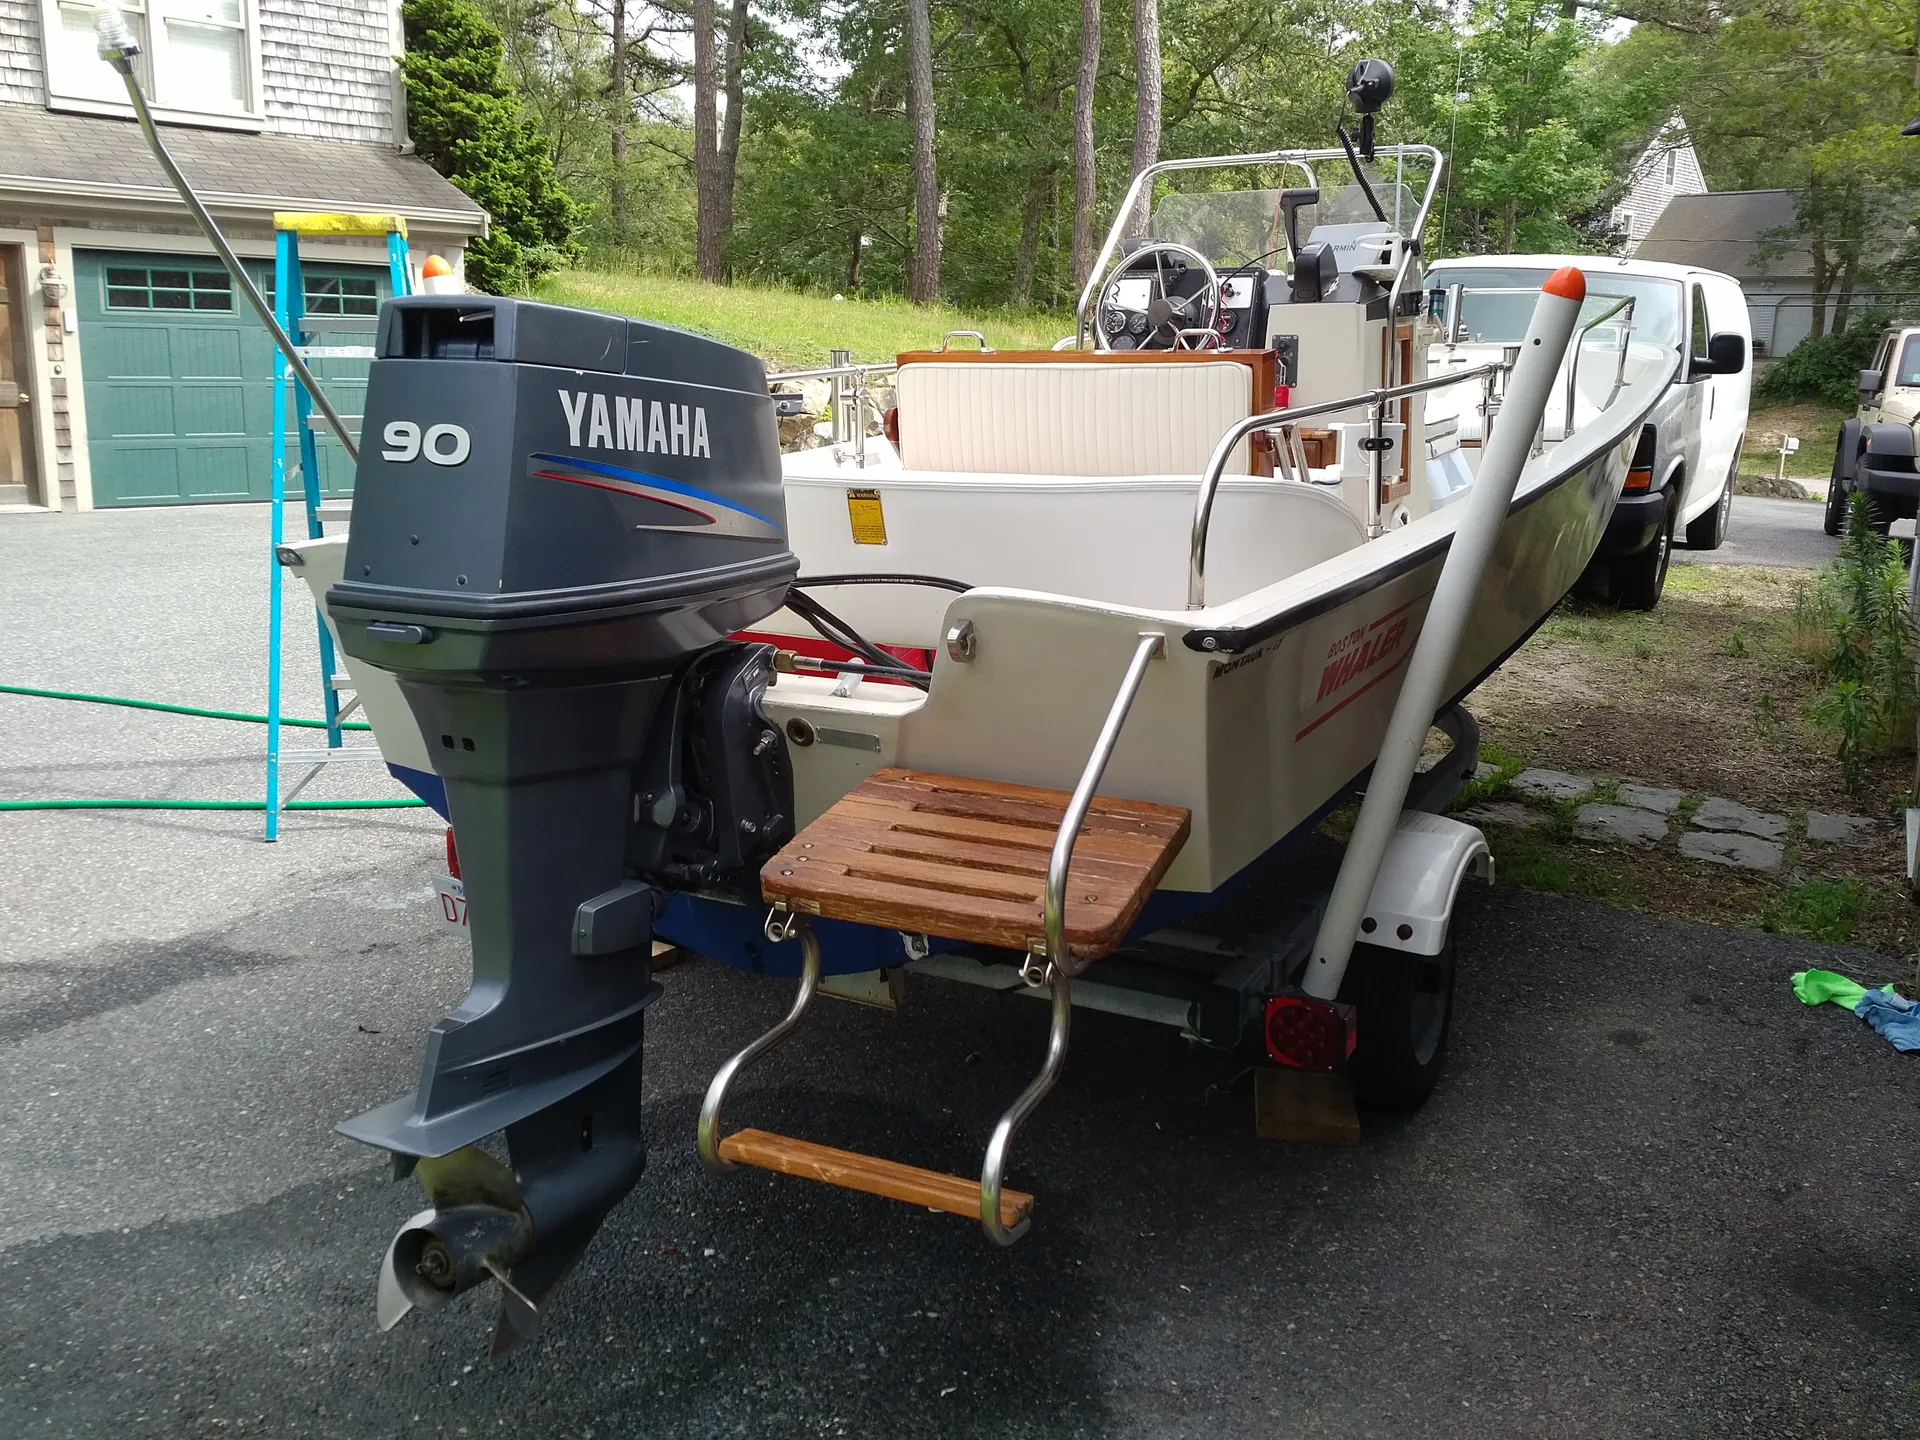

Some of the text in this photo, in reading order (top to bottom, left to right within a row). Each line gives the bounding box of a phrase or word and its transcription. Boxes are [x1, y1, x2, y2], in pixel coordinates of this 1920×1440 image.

[1333, 244, 1357, 252] RMIN
[381, 420, 471, 466] 90
[558, 389, 711, 459] YAMAHA
[1316, 616, 1408, 704] WHALER
[1327, 623, 1368, 660] BOSTON
